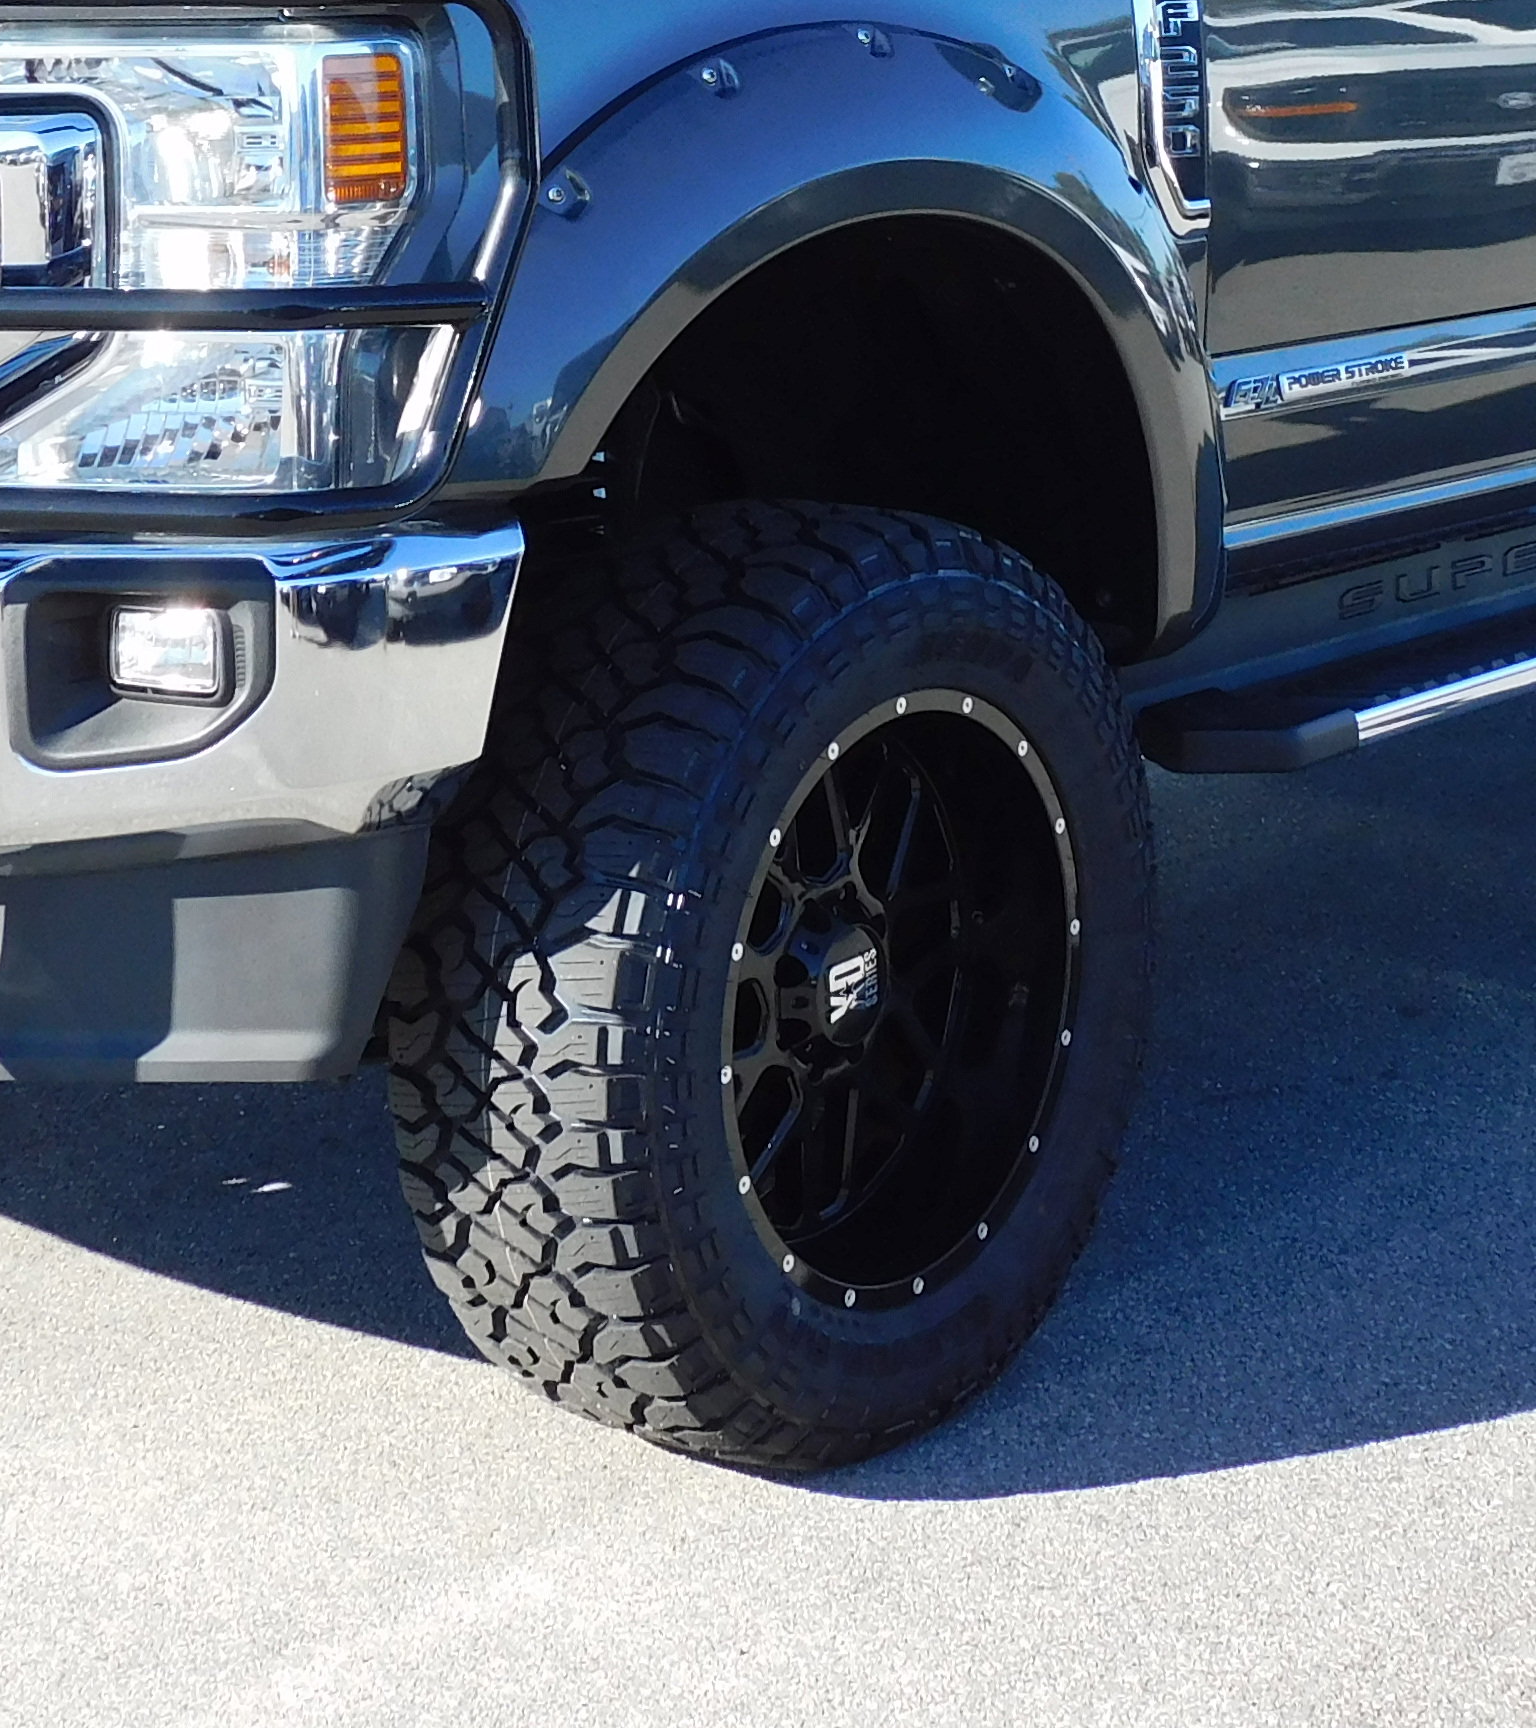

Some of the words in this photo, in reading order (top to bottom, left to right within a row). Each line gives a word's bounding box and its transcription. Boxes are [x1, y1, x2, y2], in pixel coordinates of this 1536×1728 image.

[1286, 368, 1343, 391] POWER
[1344, 355, 1405, 380] STROKE
[864, 947, 879, 1008] SERIES
